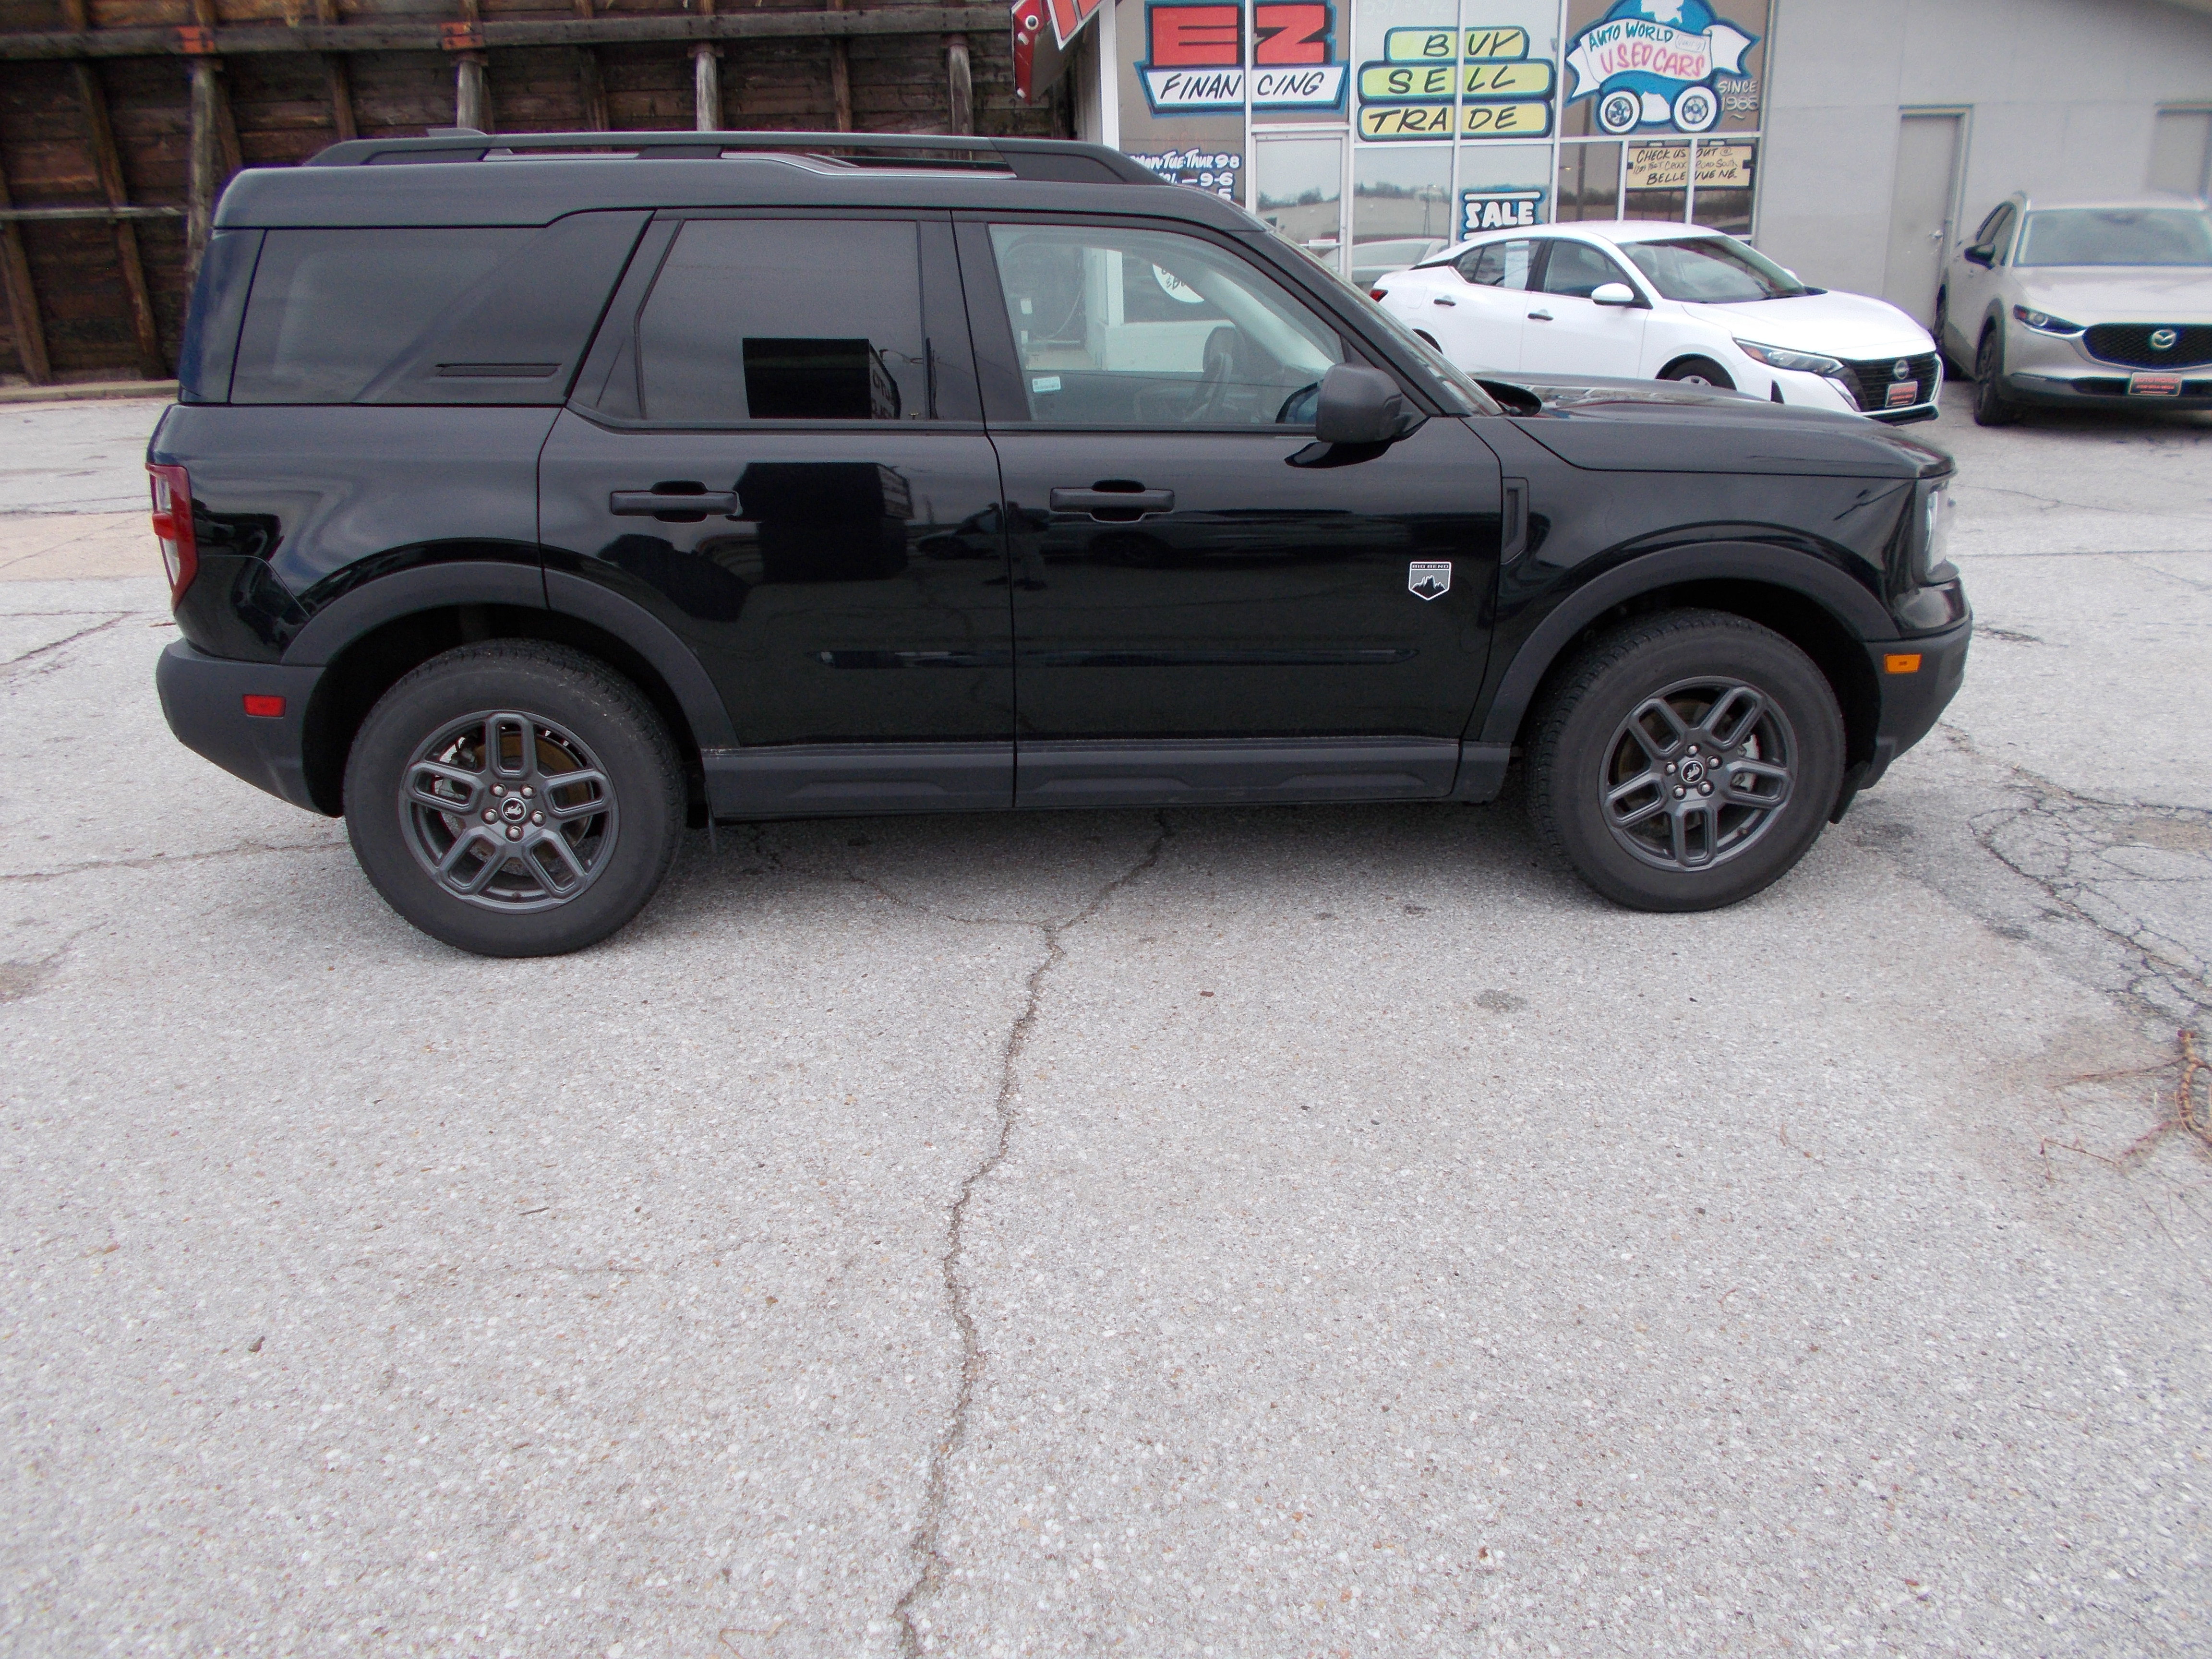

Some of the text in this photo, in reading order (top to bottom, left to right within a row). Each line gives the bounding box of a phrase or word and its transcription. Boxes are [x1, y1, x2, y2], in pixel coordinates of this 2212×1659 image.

[1153, 4, 1325, 66] EZ
[1423, 31, 1520, 57] BUY
[1588, 24, 1621, 52] AUTO
[1626, 20, 1674, 43] WORLD
[1600, 41, 1705, 77] USED CARS
[1159, 72, 1324, 100] FINANCING
[1388, 66, 1515, 94] SELL
[1718, 81, 1758, 94] SINCE
[1369, 106, 1517, 133] TRADE
[1637, 149, 1670, 163] CHECK
[1673, 149, 1686, 158] US
[1696, 148, 1718, 157] OUT
[1646, 170, 1716, 186] BELLEVUE
[1466, 202, 1534, 229] SALE
